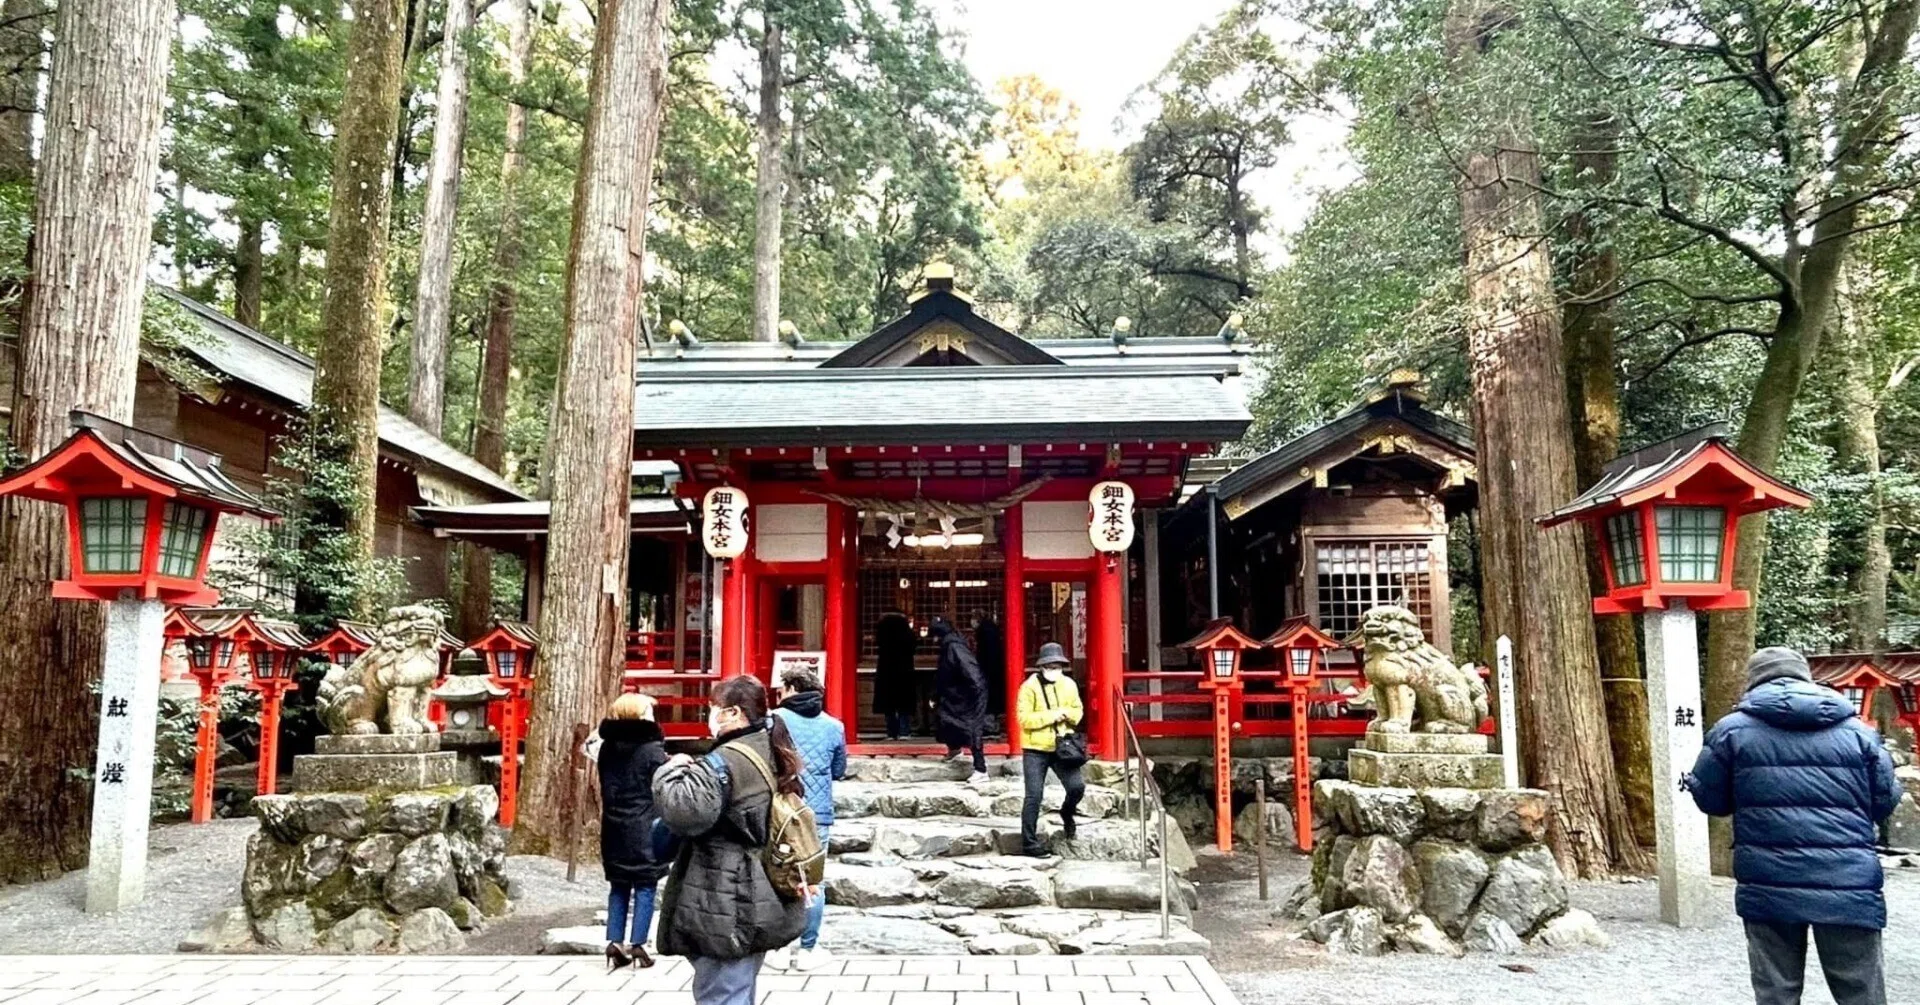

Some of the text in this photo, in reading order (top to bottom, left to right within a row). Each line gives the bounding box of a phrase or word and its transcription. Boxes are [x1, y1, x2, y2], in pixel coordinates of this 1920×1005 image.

[710, 491, 733, 548] 鈿女本宮
[1102, 485, 1125, 542] 鈿女本宮
[101, 696, 128, 783] 献燈
